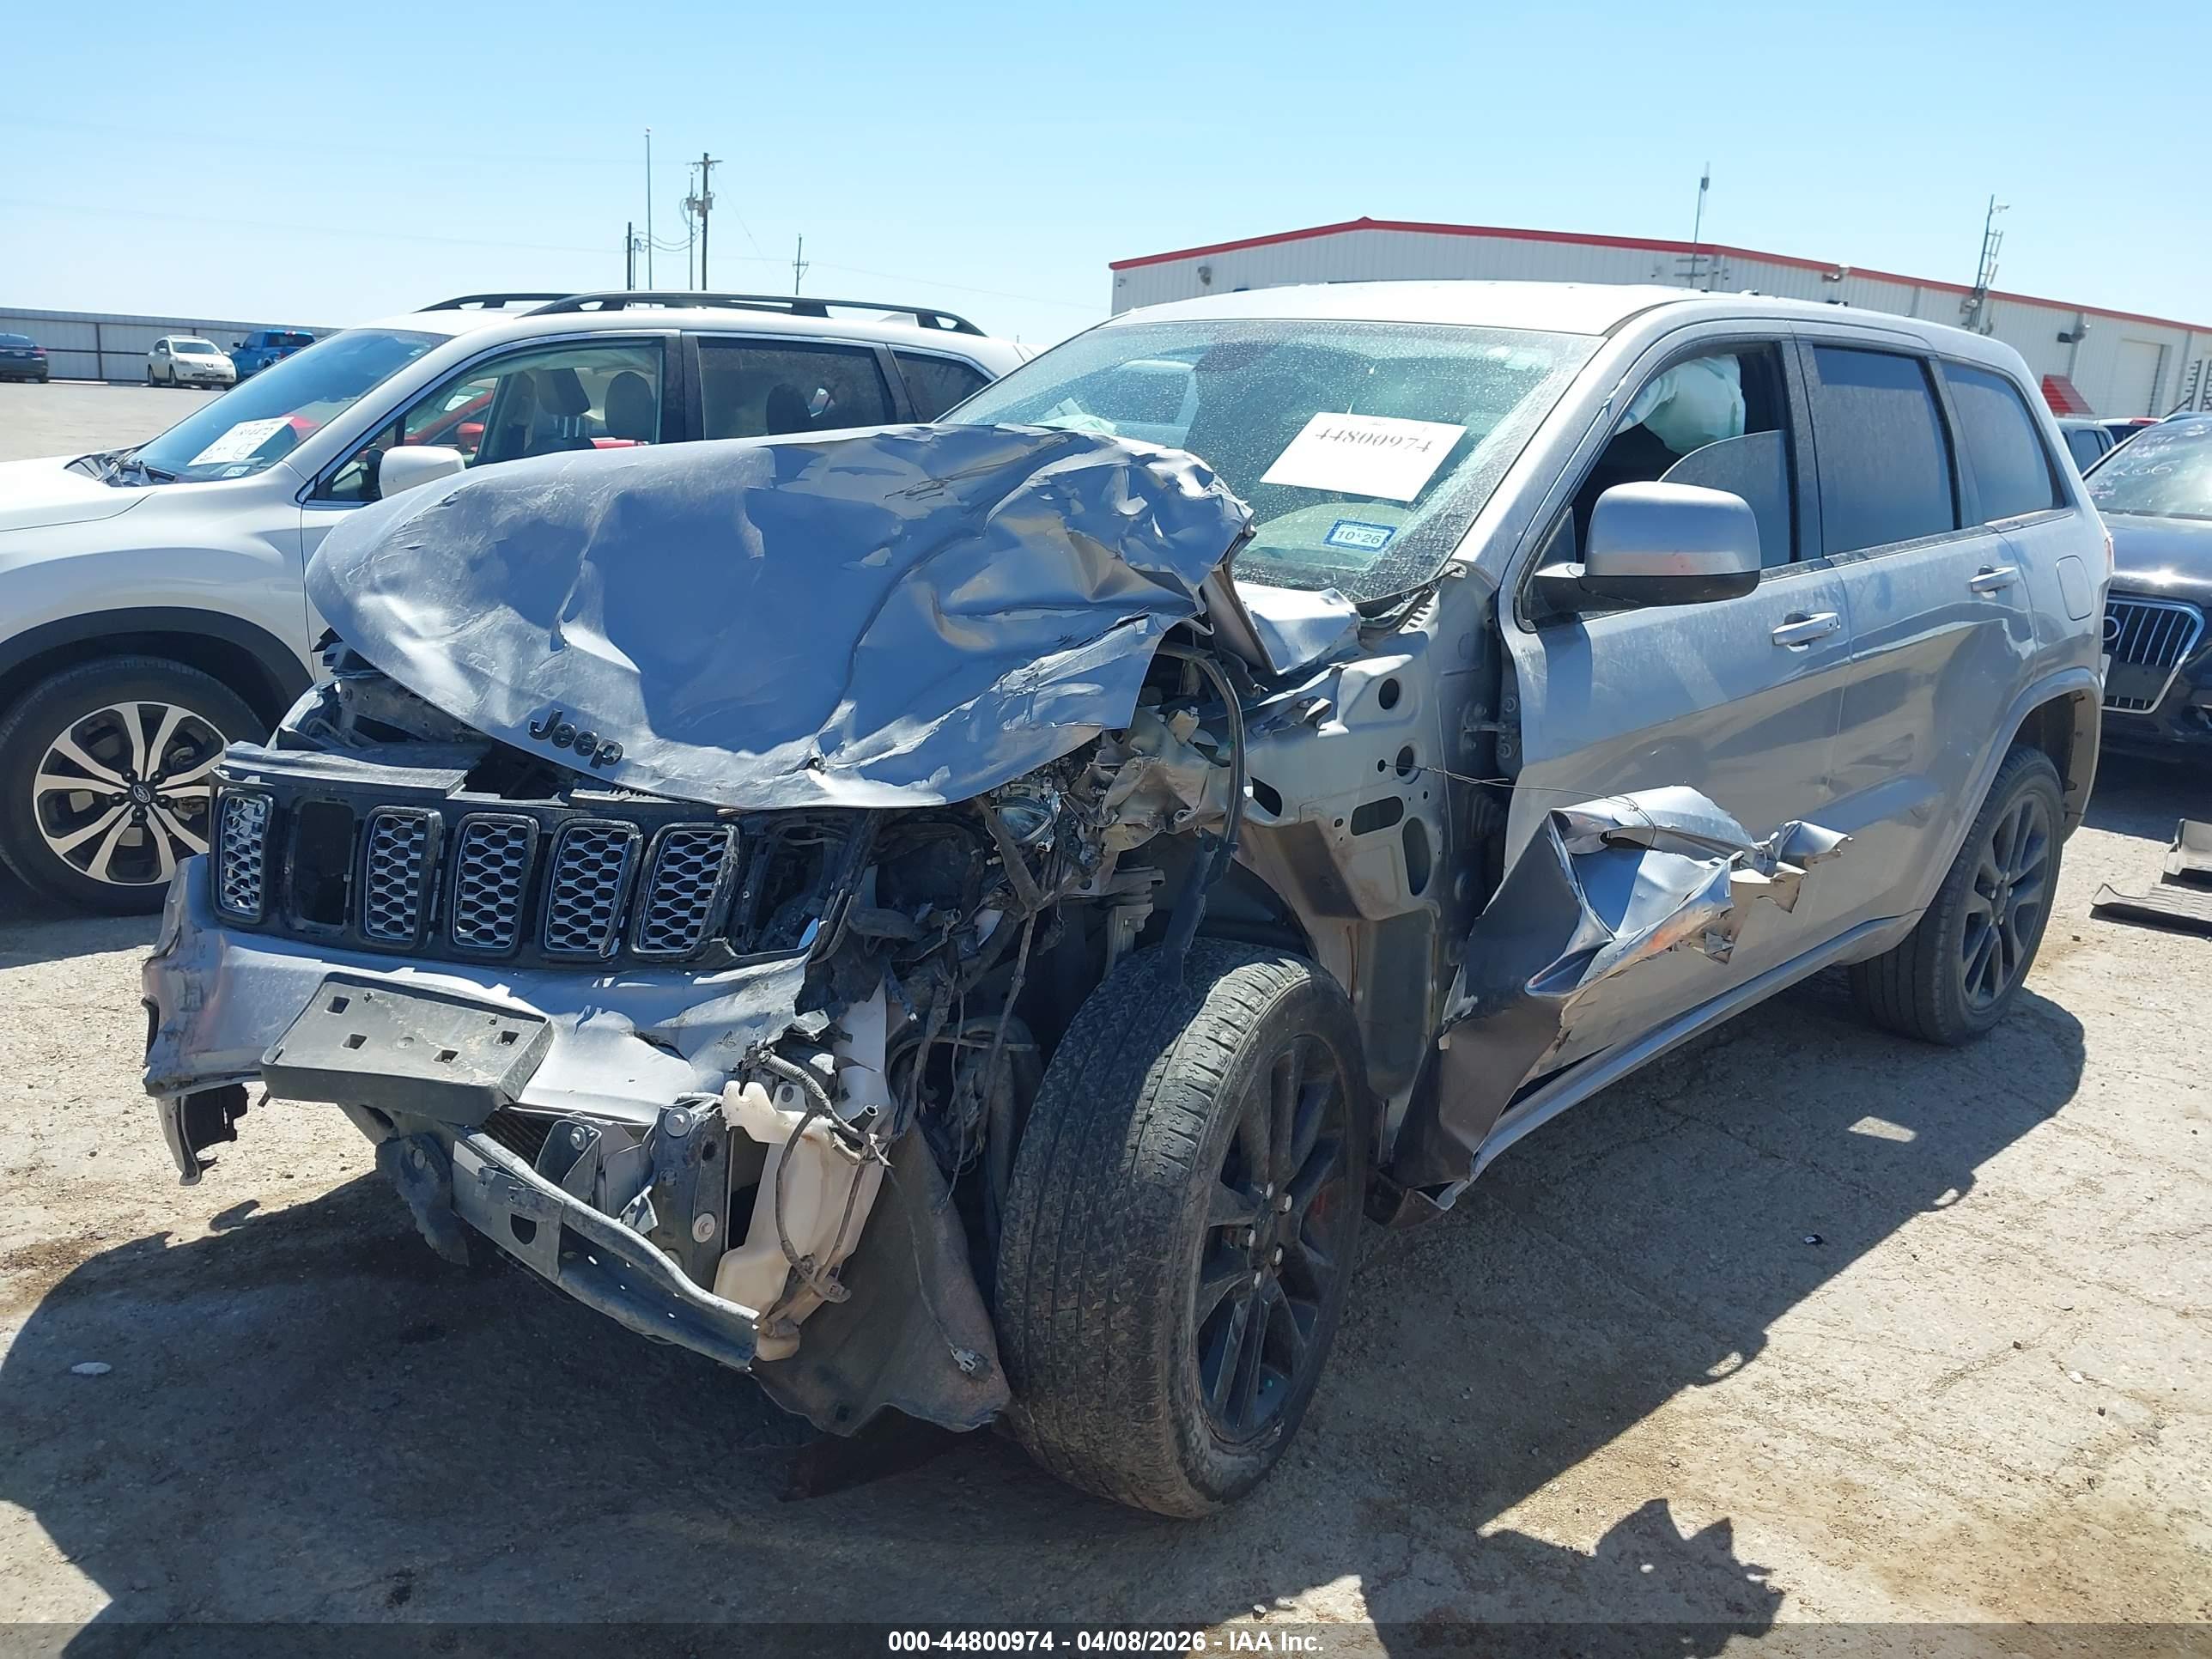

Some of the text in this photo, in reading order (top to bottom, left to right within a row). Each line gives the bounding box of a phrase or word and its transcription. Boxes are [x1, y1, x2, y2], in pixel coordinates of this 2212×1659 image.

[1316, 428, 1433, 453] 44800974
[1338, 530, 1356, 540] 10
[1361, 533, 1382, 544] 26
[528, 708, 625, 769] Jeep
